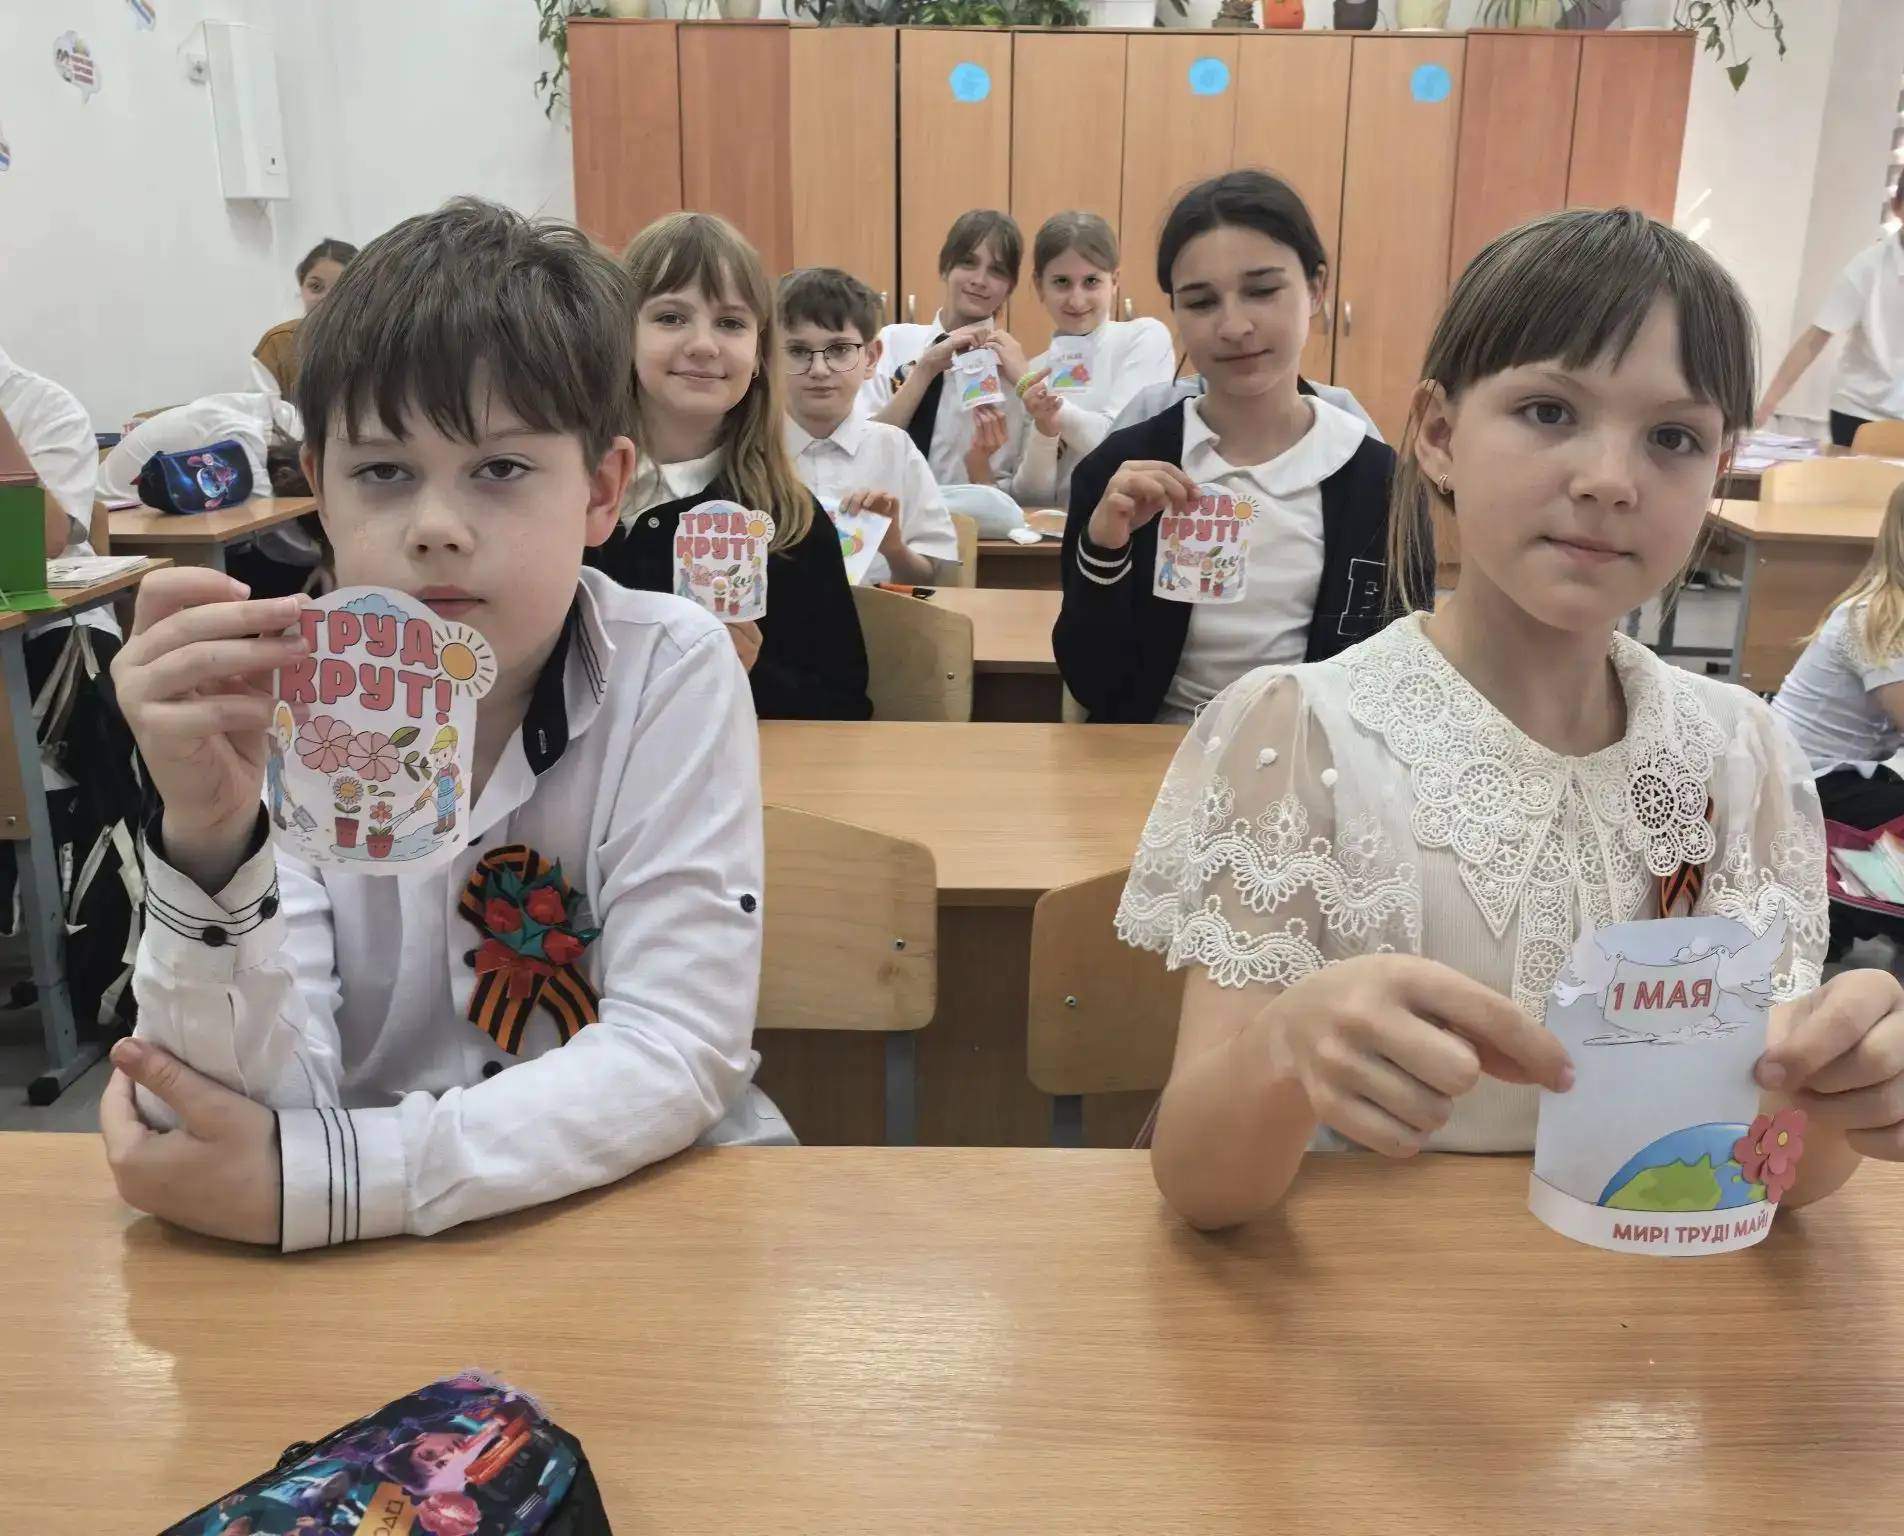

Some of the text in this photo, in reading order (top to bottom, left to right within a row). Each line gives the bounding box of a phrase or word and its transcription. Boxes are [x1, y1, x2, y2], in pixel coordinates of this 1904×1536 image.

[681, 512, 748, 535] ТРУД
[1161, 517, 1240, 543] КРУТ!
[676, 536, 756, 561] КРУТ!
[280, 657, 452, 725] КРУТ!
[1613, 979, 1713, 1010] 1 МАЯ
[1612, 1223, 1669, 1243] МИР!
[1675, 1223, 1730, 1243] ТРУД!
